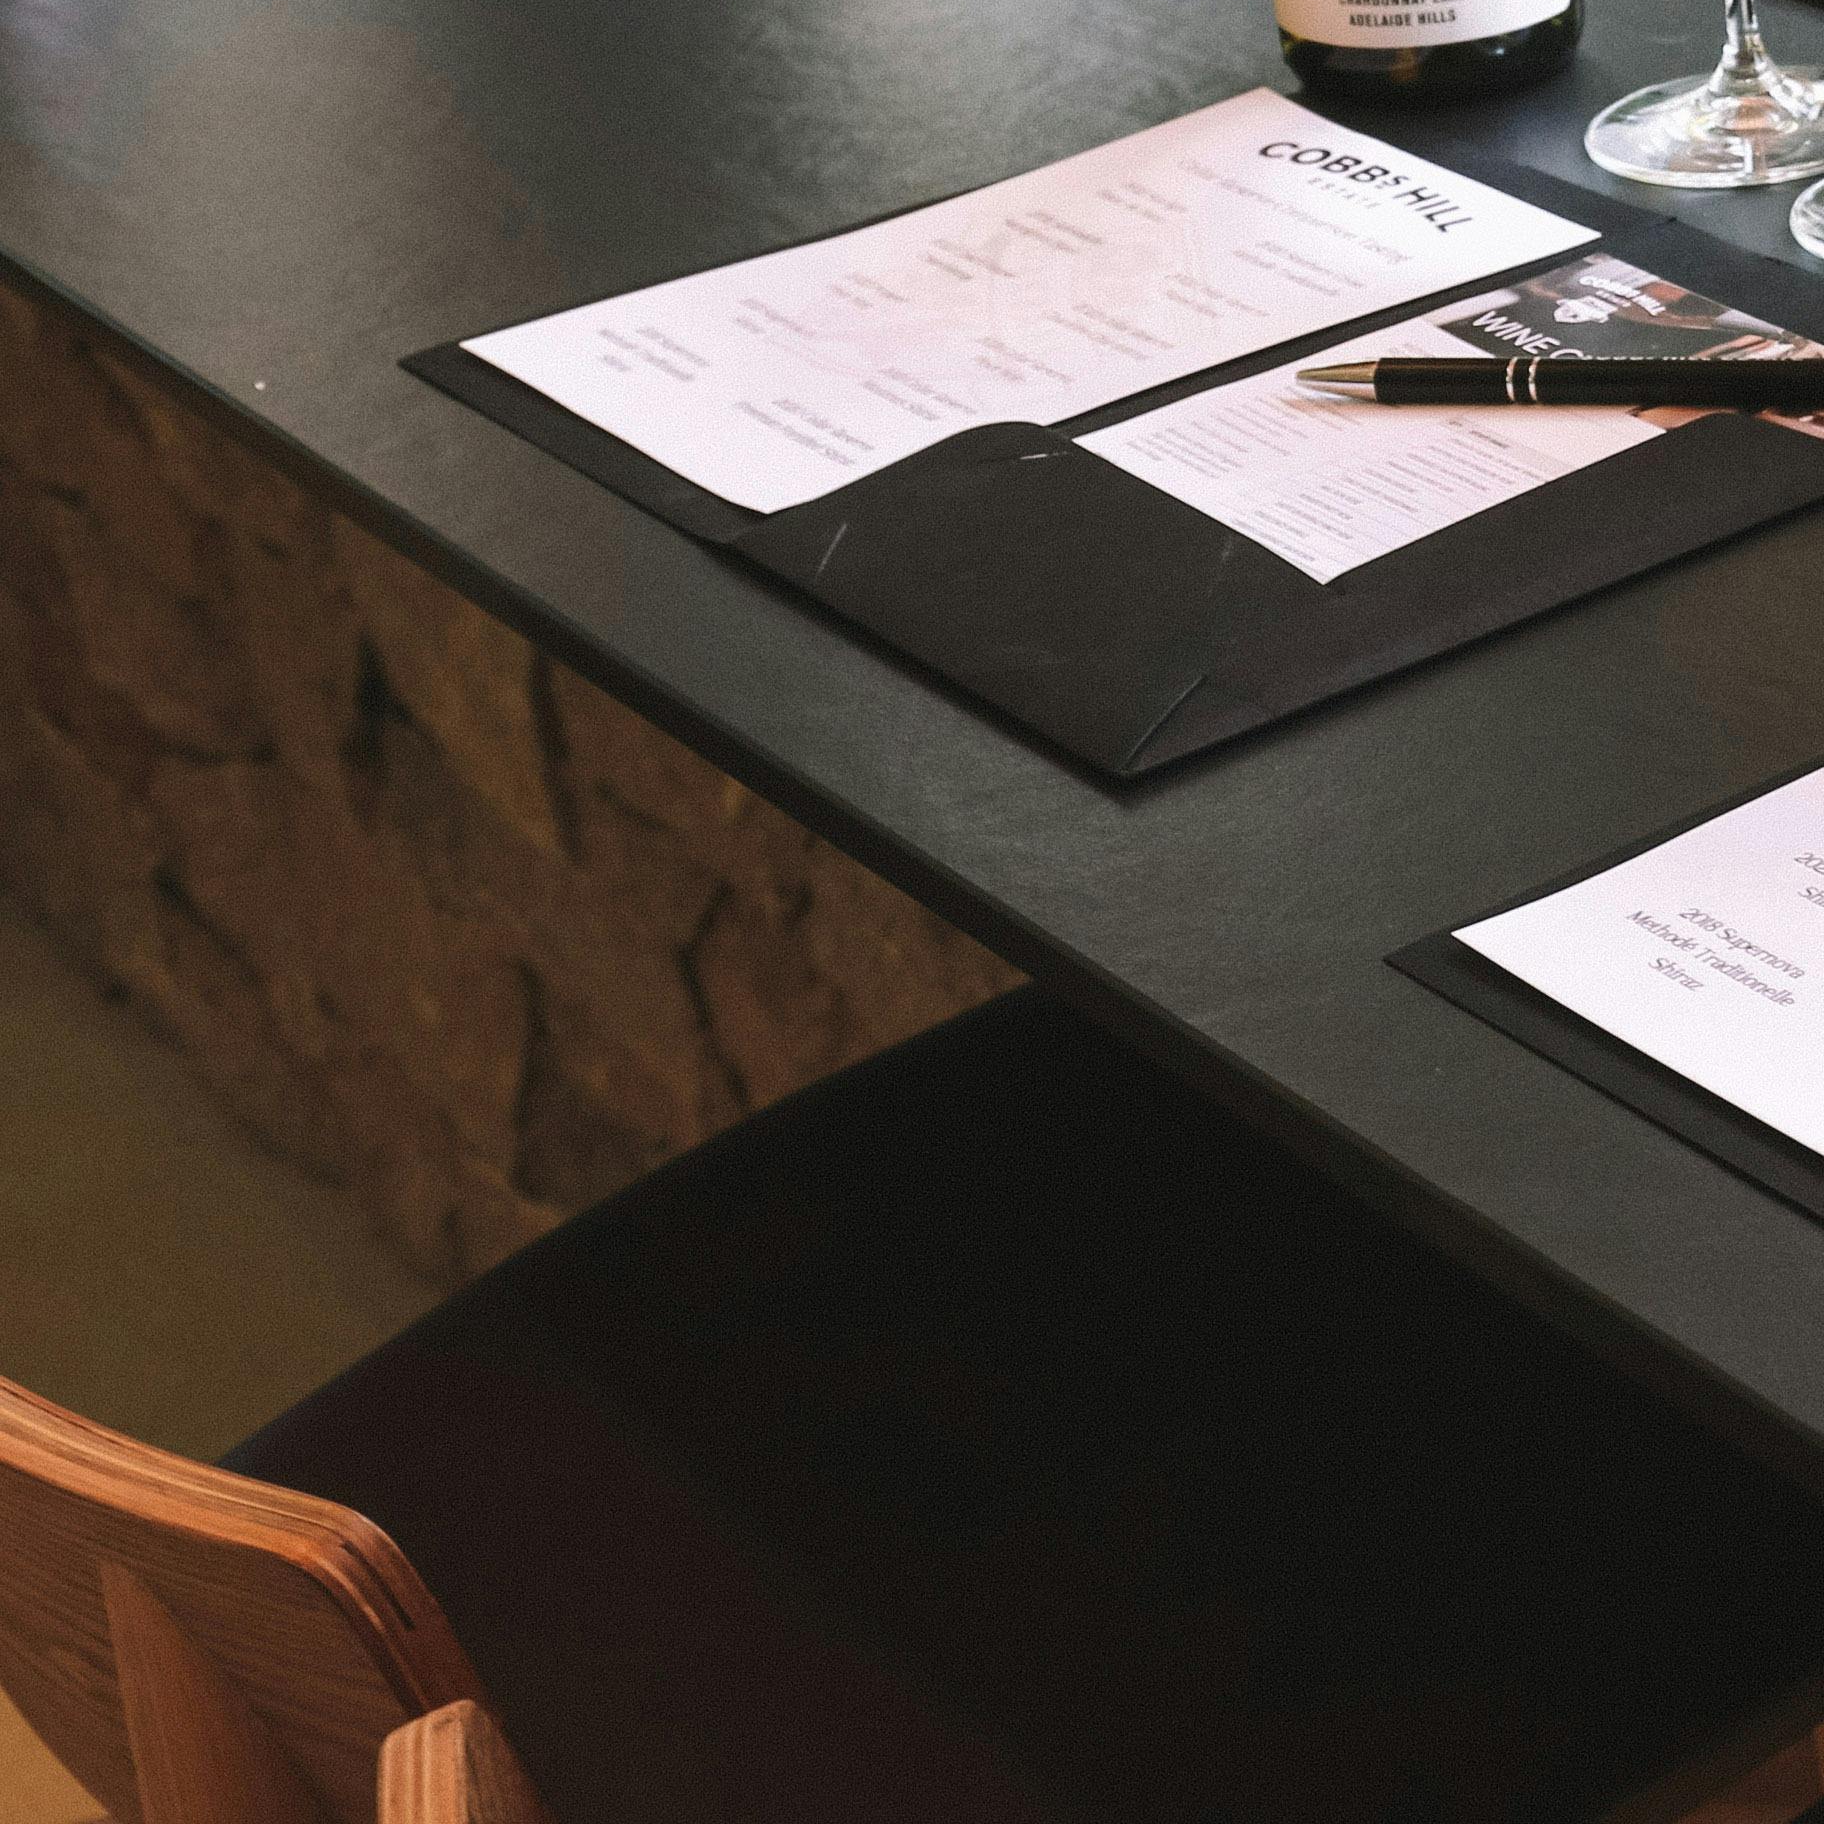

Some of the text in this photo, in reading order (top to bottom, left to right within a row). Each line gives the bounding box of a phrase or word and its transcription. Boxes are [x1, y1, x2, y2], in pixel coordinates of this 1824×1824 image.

[1348, 9, 1457, 27] ADELAIDE HILLS
[1393, 186, 1473, 233] HILL
[1472, 310, 1560, 356] WINE
[1647, 957, 1705, 992] Shiraz
[1693, 947, 1796, 1006] Traditionelle
[1715, 927, 1806, 980] Supernova
